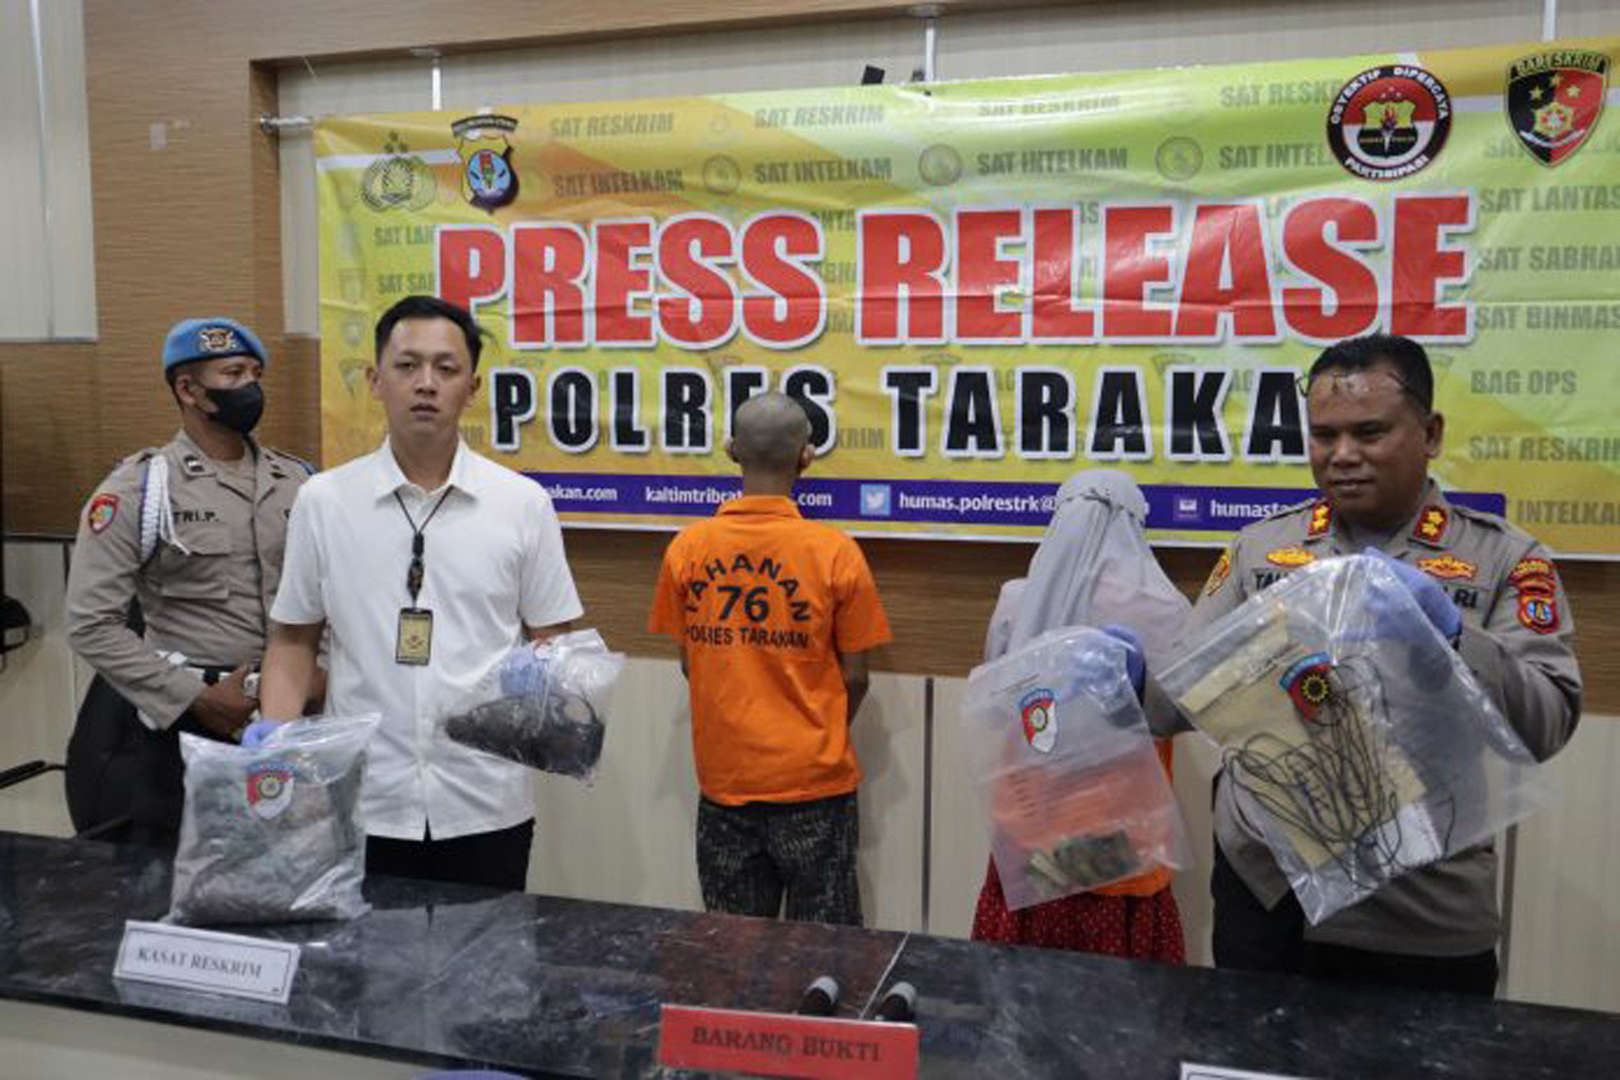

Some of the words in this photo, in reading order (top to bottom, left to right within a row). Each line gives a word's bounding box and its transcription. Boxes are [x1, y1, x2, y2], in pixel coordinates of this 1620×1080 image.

[1219, 84, 1262, 106] SAT
[1266, 80, 1338, 104] RESK
[550, 116, 582, 136] SAT
[586, 112, 673, 135] RESKRIM
[755, 108, 789, 128] SAT
[793, 104, 884, 127] RESKRIM
[977, 152, 1014, 175] SAT
[1020, 147, 1127, 173] INTELKAM
[1220, 145, 1260, 169] SAT
[1265, 143, 1336, 168] INTEL
[754, 162, 788, 184] SAT
[793, 157, 893, 183] INTELKAM
[555, 174, 587, 197] SAT
[1481, 188, 1525, 212] SAT
[374, 226, 402, 246] SAT
[435, 210, 828, 349] PRESS
[856, 192, 1475, 347] RELEASE
[1479, 246, 1521, 270] SAT
[1528, 245, 1620, 271] SABHA
[1475, 304, 1518, 330] SAT
[1471, 370, 1521, 394] BAG
[1528, 369, 1577, 394] OPS
[880, 364, 1309, 463] TARAKA
[1469, 436, 1514, 460] SAT
[1516, 500, 1620, 524] INTELKA
[717, 585, 770, 623] 76
[137, 949, 189, 968] KASAT
[190, 953, 263, 979] RESKRIM
[691, 1026, 794, 1056] BARANG
[802, 1035, 881, 1062] BUKTI
